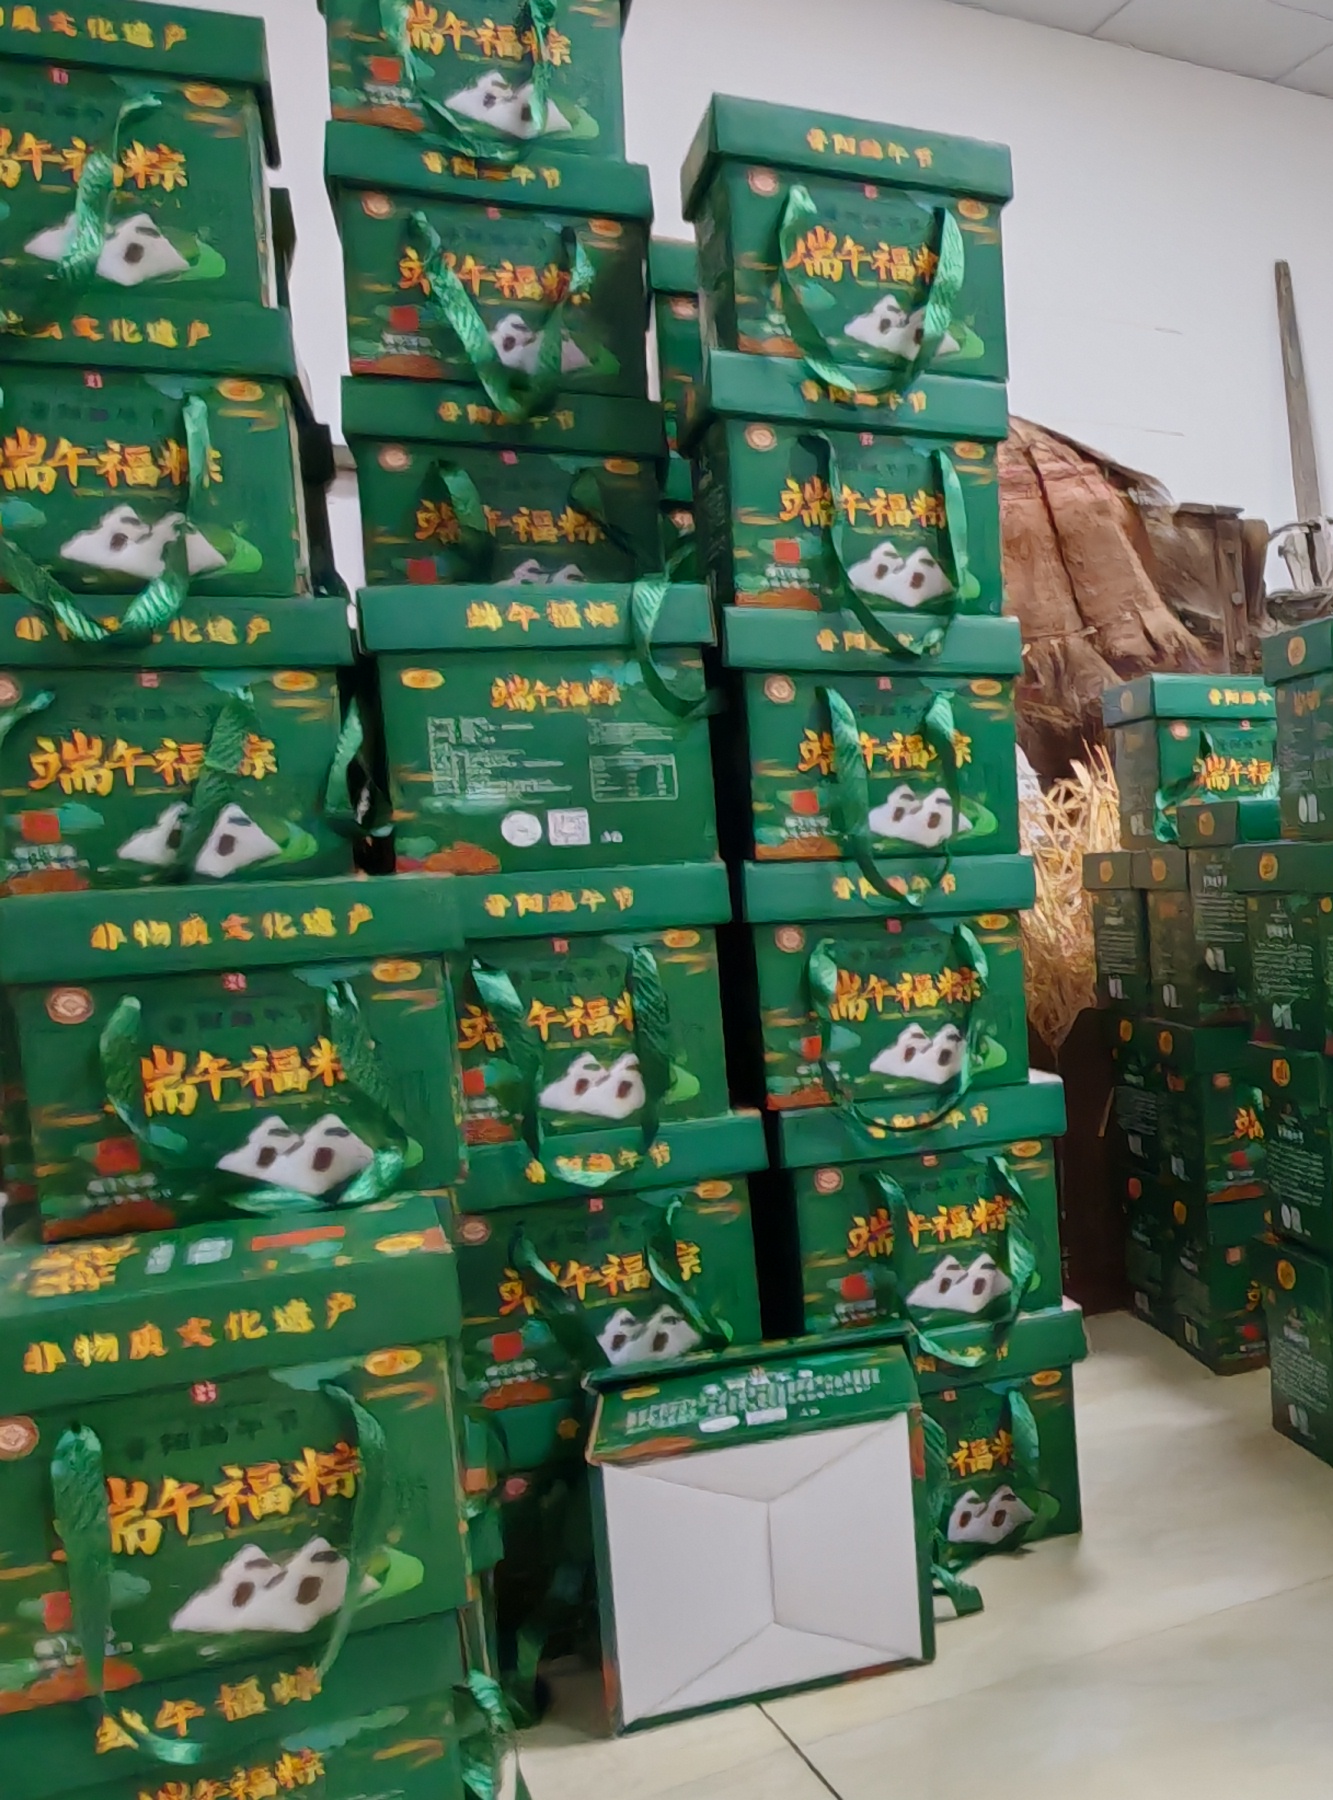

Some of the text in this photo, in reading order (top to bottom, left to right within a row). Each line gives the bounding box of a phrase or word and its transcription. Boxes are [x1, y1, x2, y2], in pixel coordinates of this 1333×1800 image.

[490, 672, 622, 713] 端午福粽
[91, 902, 373, 951] 非物质文化遗产
[23, 1290, 357, 1375] 非物质文化遗产
